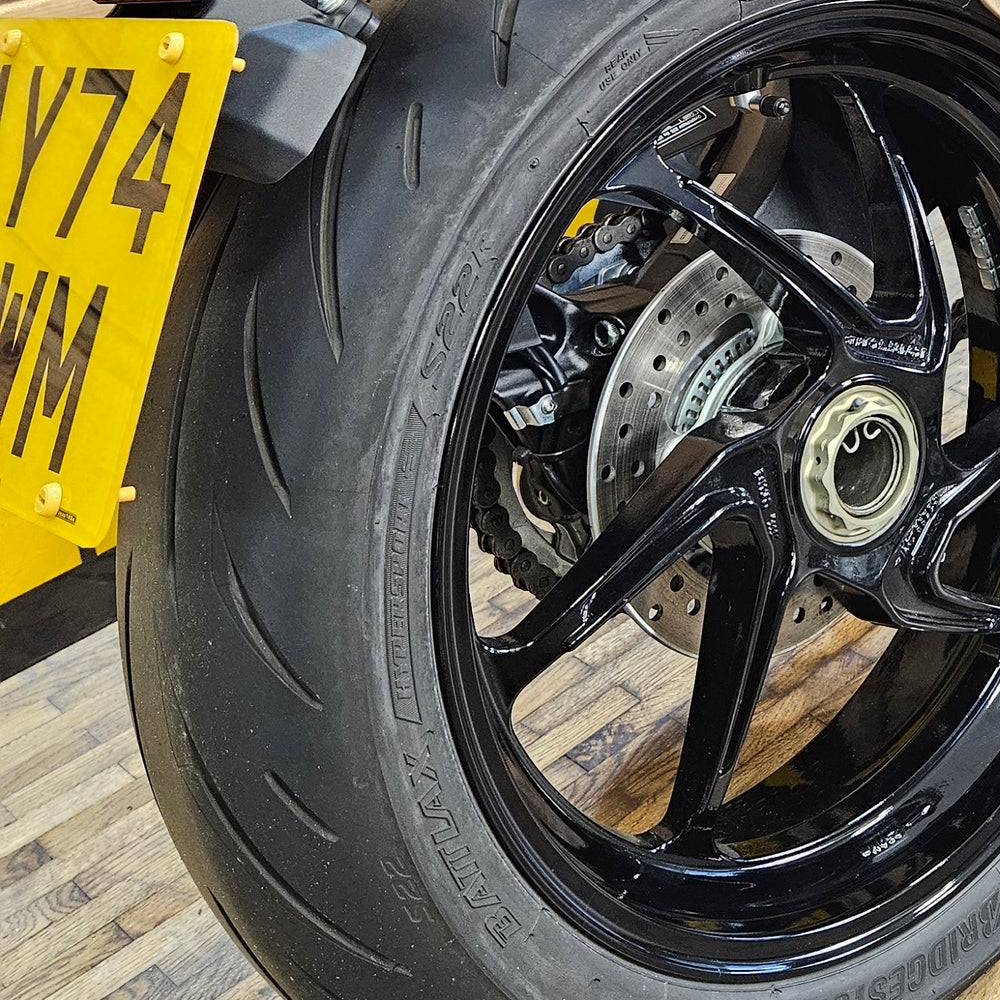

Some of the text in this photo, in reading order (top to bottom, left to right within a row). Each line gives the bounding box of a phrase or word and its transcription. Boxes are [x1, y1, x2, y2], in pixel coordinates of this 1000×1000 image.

[0, 64, 192, 254] Y74
[0, 262, 109, 474] WM
[402, 745, 522, 949] BATTLAX
